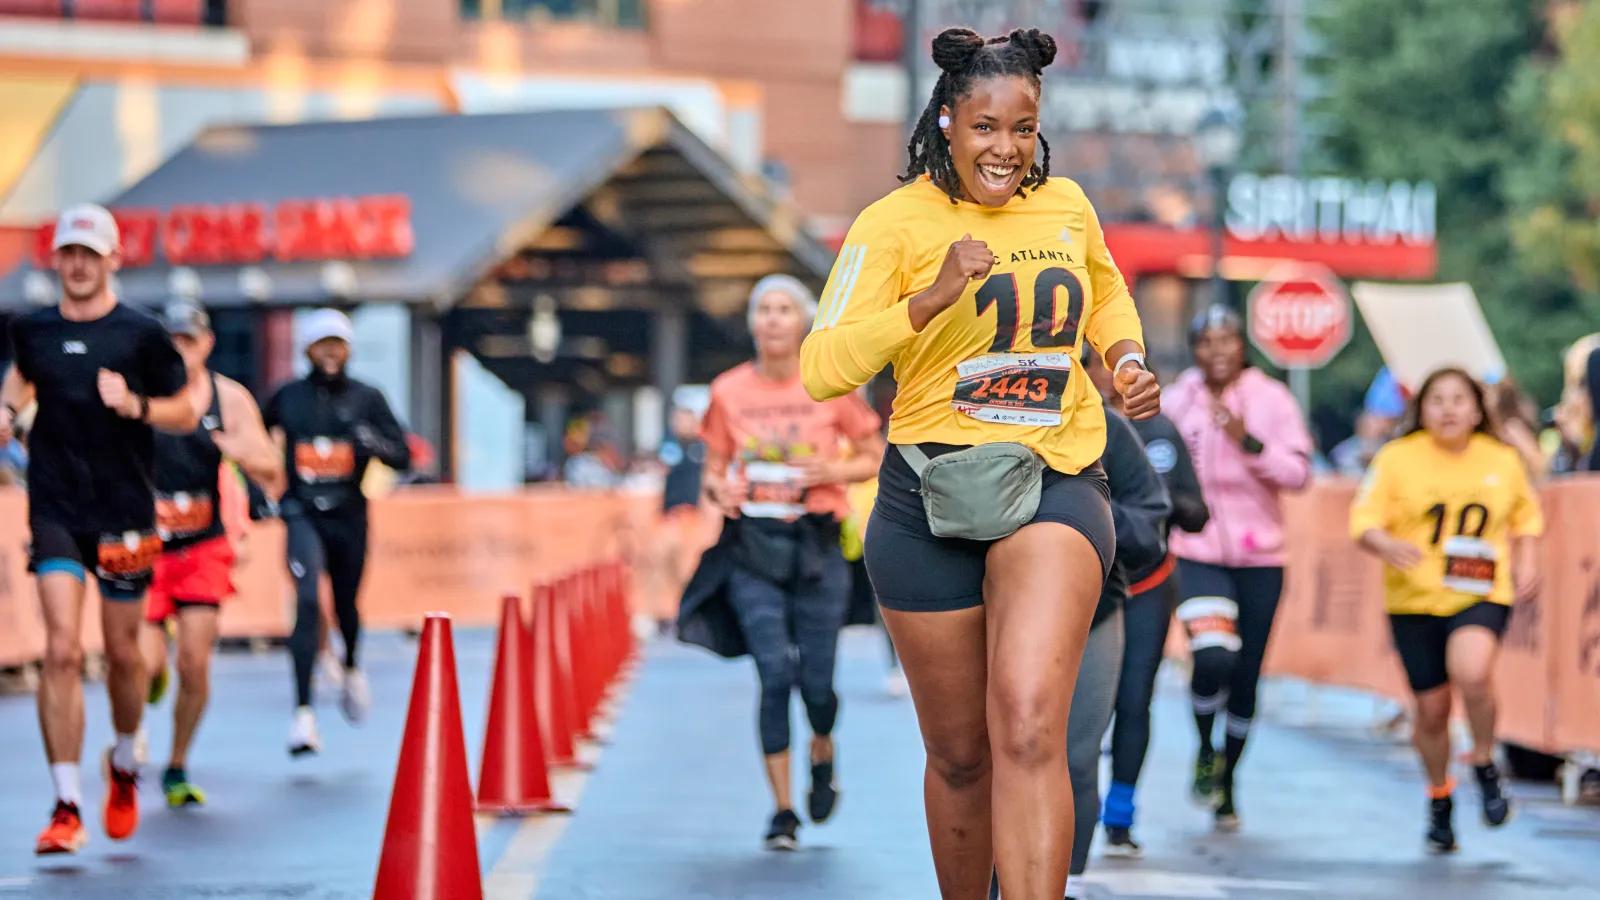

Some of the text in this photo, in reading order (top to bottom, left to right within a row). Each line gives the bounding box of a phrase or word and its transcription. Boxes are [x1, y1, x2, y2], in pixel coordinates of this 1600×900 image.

[1011, 249, 1074, 264] ATLANTA
[974, 266, 1085, 352] 10
[1253, 294, 1341, 339] STOP
[1018, 359, 1039, 367] 5K
[970, 377, 1049, 402] 2443
[1425, 503, 1489, 545] 10
